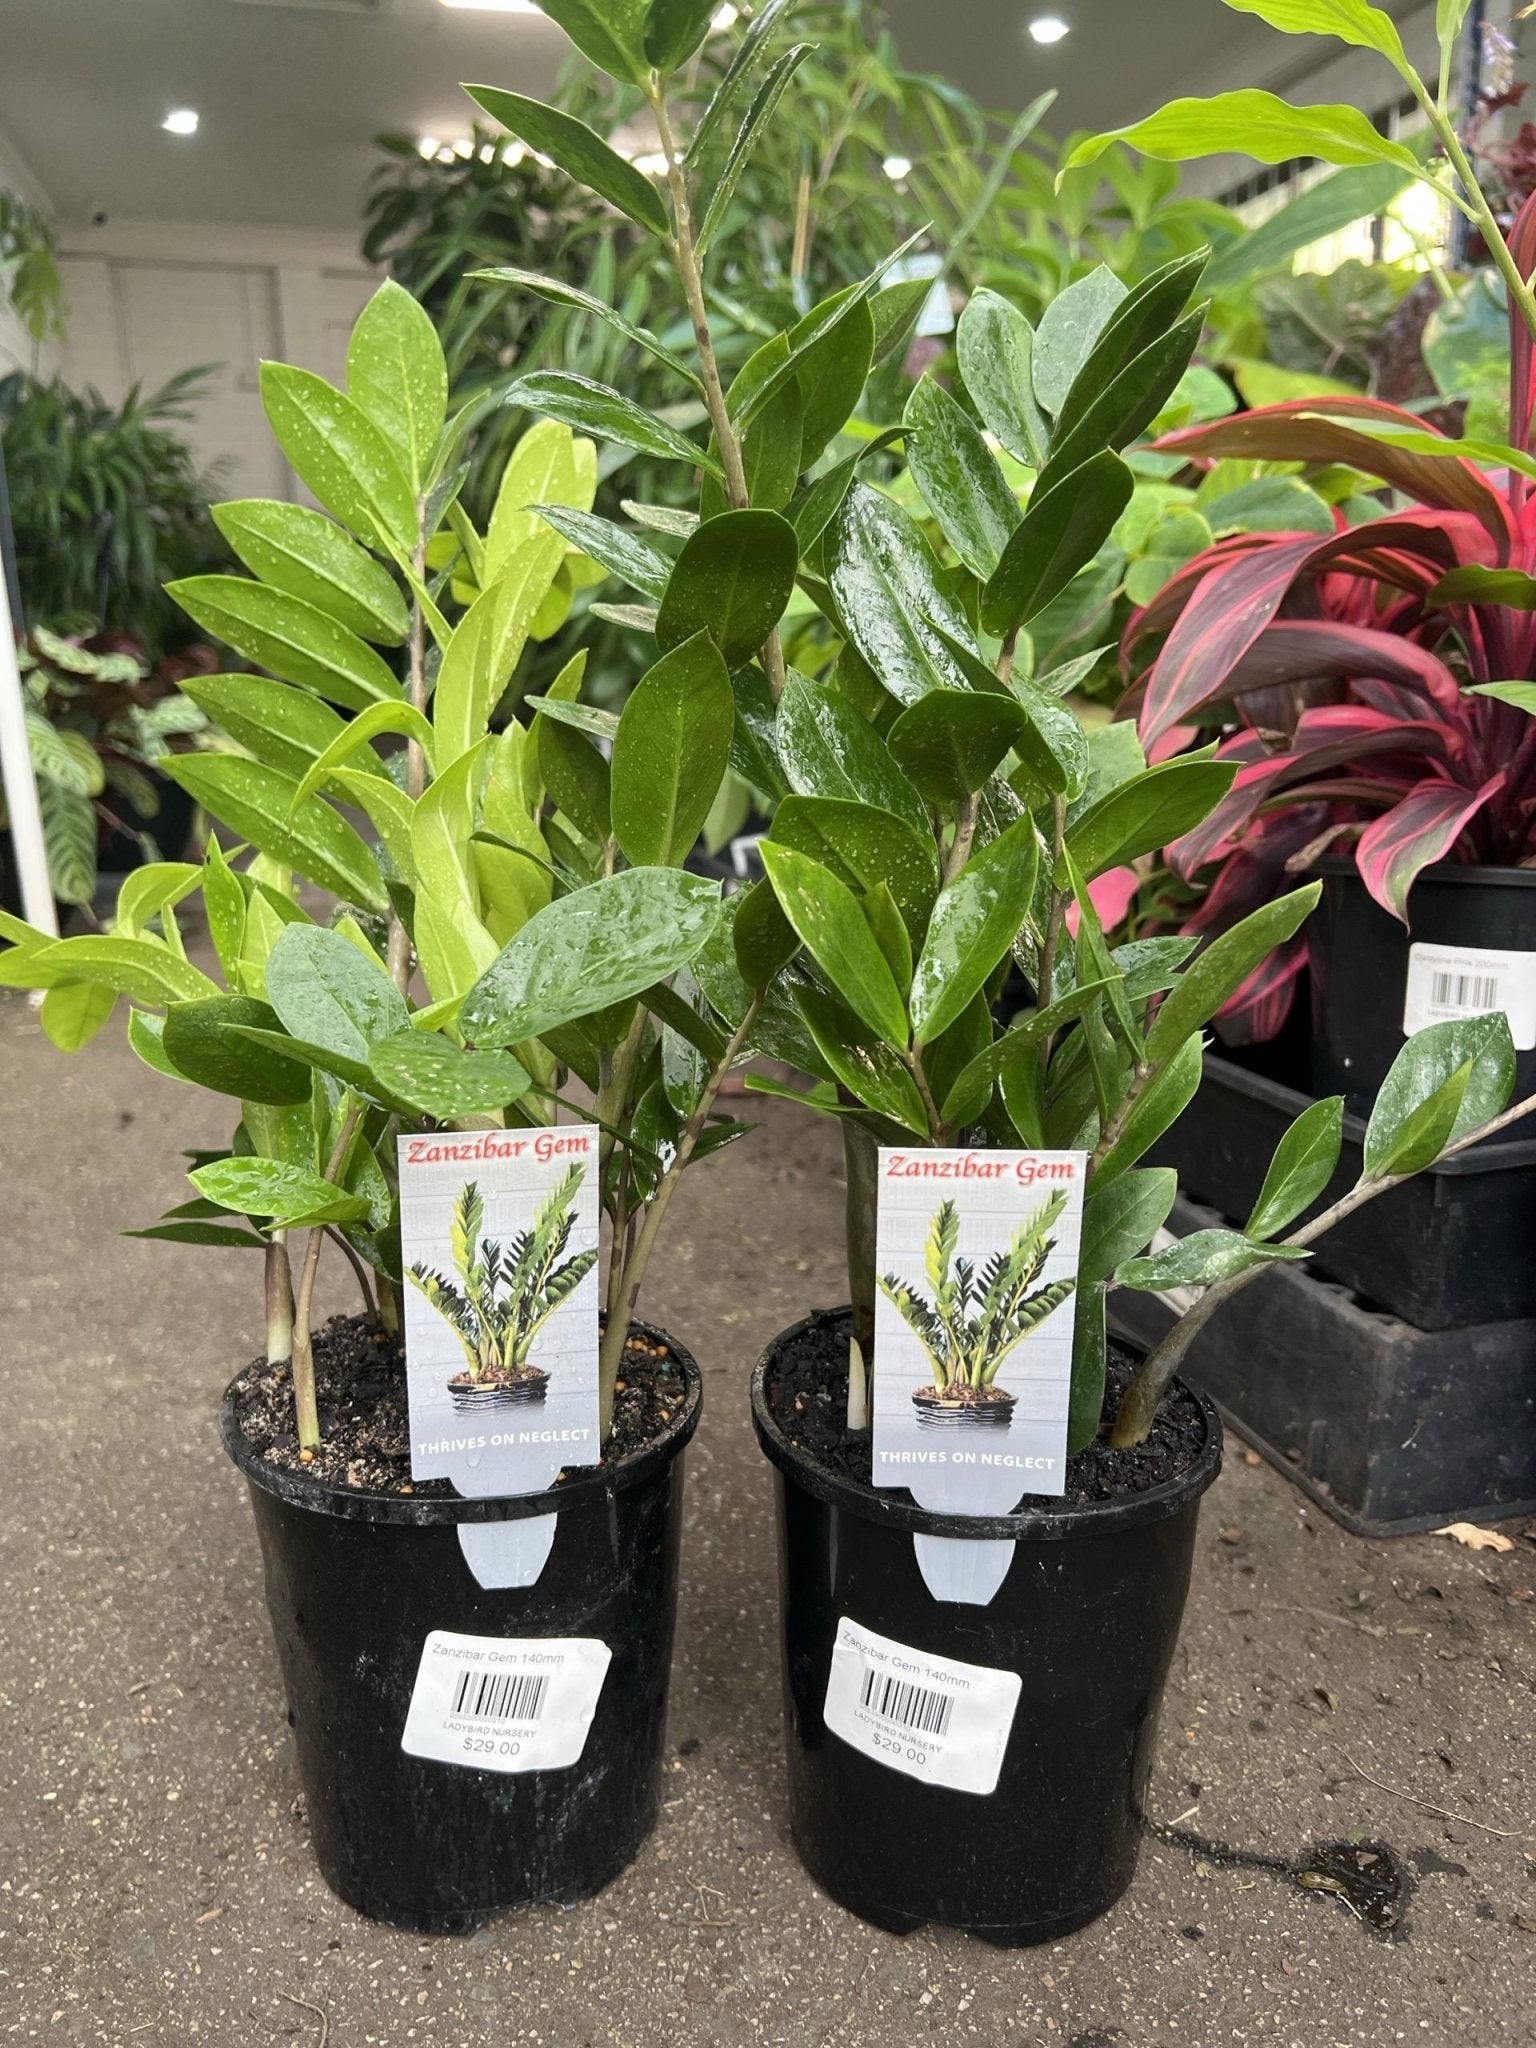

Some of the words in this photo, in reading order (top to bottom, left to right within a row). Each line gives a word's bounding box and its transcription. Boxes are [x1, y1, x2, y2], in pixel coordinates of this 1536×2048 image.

[407, 1133, 526, 1163] Zanzibar
[535, 1134, 590, 1162] Gem
[887, 1152, 1009, 1178] Zanzibar
[1016, 1157, 1075, 1185] Gem
[418, 1435, 486, 1456] THRIVES
[490, 1433, 514, 1446] ON
[519, 1429, 590, 1443] NEGLECT
[879, 1451, 947, 1463] THRIVES
[952, 1451, 976, 1464] ON
[981, 1454, 1055, 1470] NEGLECT
[432, 1643, 486, 1662] Zanzibar
[488, 1651, 518, 1664] Gem
[522, 1653, 565, 1664] 140mm
[843, 1631, 889, 1662] Zanzibar
[891, 1656, 921, 1675] Gem
[924, 1668, 971, 1689] 140mm
[443, 1721, 490, 1735] LADYBIRD
[491, 1728, 537, 1739] NURSERY
[854, 1710, 897, 1737] LADYBIRD
[899, 1733, 944, 1753] NURSERY
[462, 1737, 521, 1756] $29.00
[872, 1732, 926, 1765] $29.00
